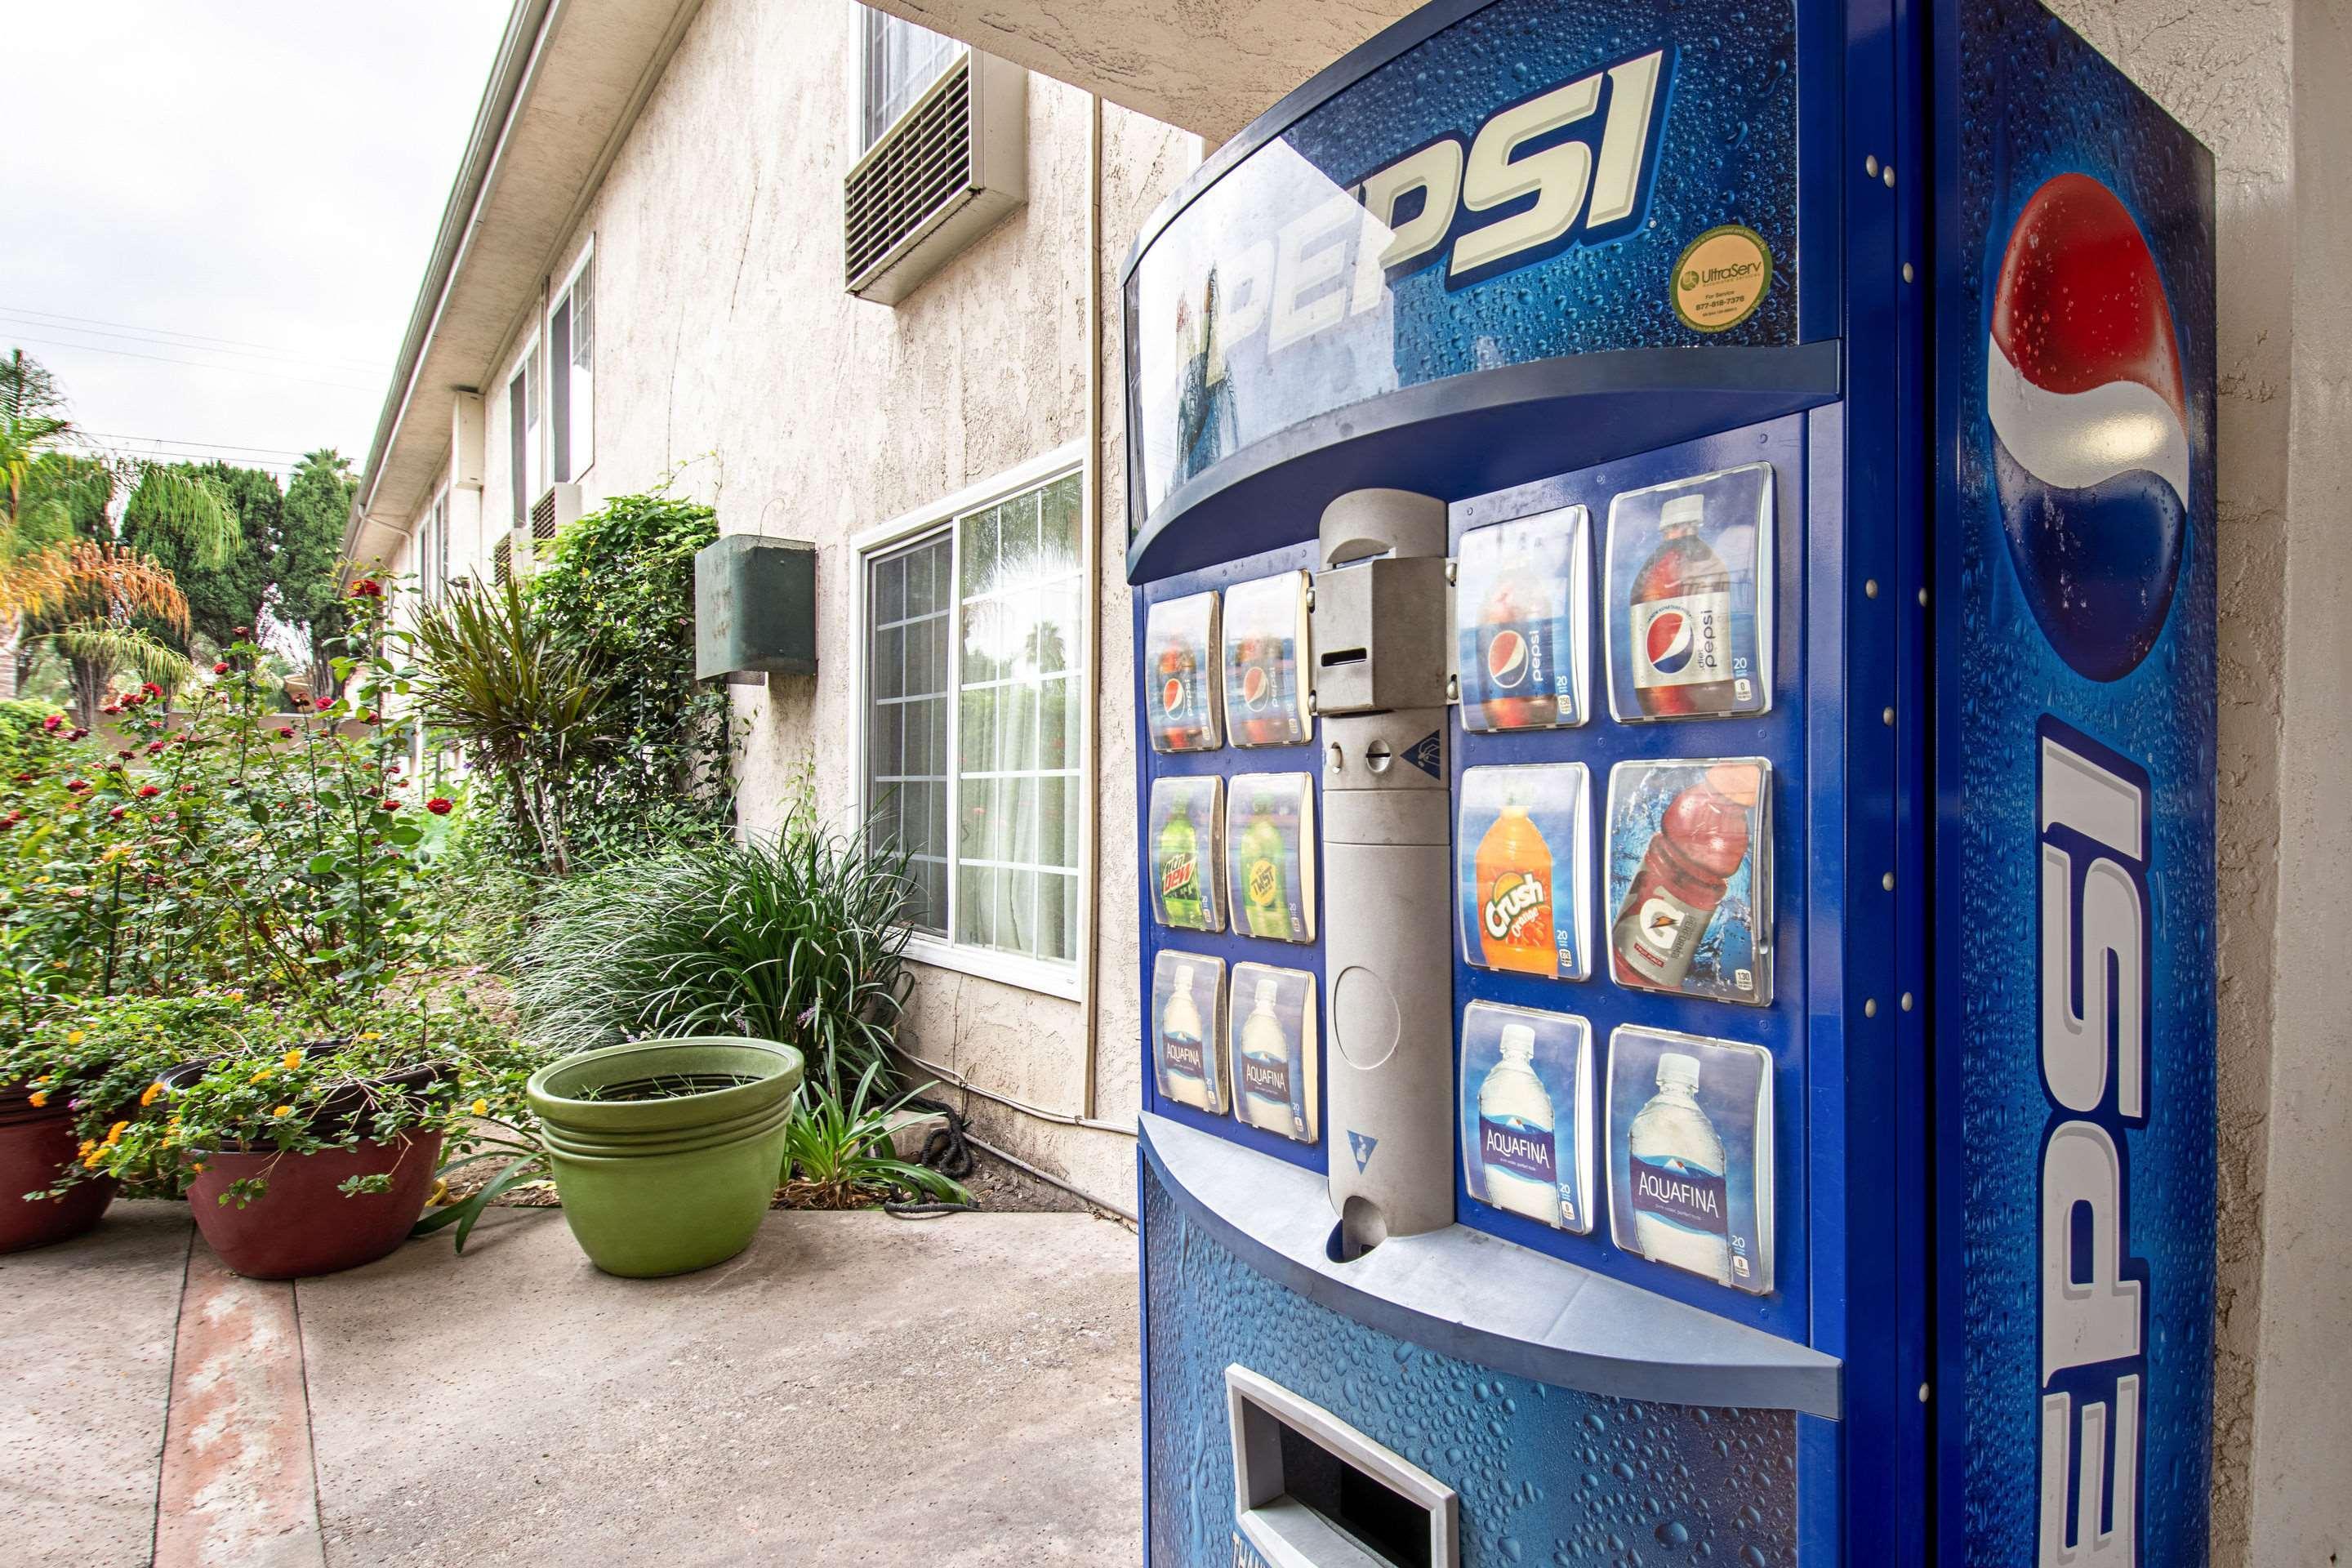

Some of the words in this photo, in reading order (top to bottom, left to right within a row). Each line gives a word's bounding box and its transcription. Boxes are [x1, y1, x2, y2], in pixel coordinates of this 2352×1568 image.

[1206, 49, 1664, 386] PEPSI
[1703, 261, 1762, 283] UltraServ
[1701, 609, 1717, 667] pepsi
[1529, 630, 1544, 681] pepsi
[1734, 657, 1747, 669] 20
[1557, 675, 1568, 686] 20
[1185, 679, 1194, 716] pepsi
[1485, 872, 1544, 938] Crush
[1557, 929, 1568, 940] 20
[1737, 972, 1750, 980] 130
[1167, 1043, 1201, 1069] AQUAFINA
[1246, 1064, 1286, 1092] AQUAFINA
[1486, 1129, 1550, 1169] AQUAFINA
[1560, 1183, 1570, 1193] 20
[1639, 1170, 1719, 1218] AQUAFINA
[1732, 1235, 1745, 1248] 20
